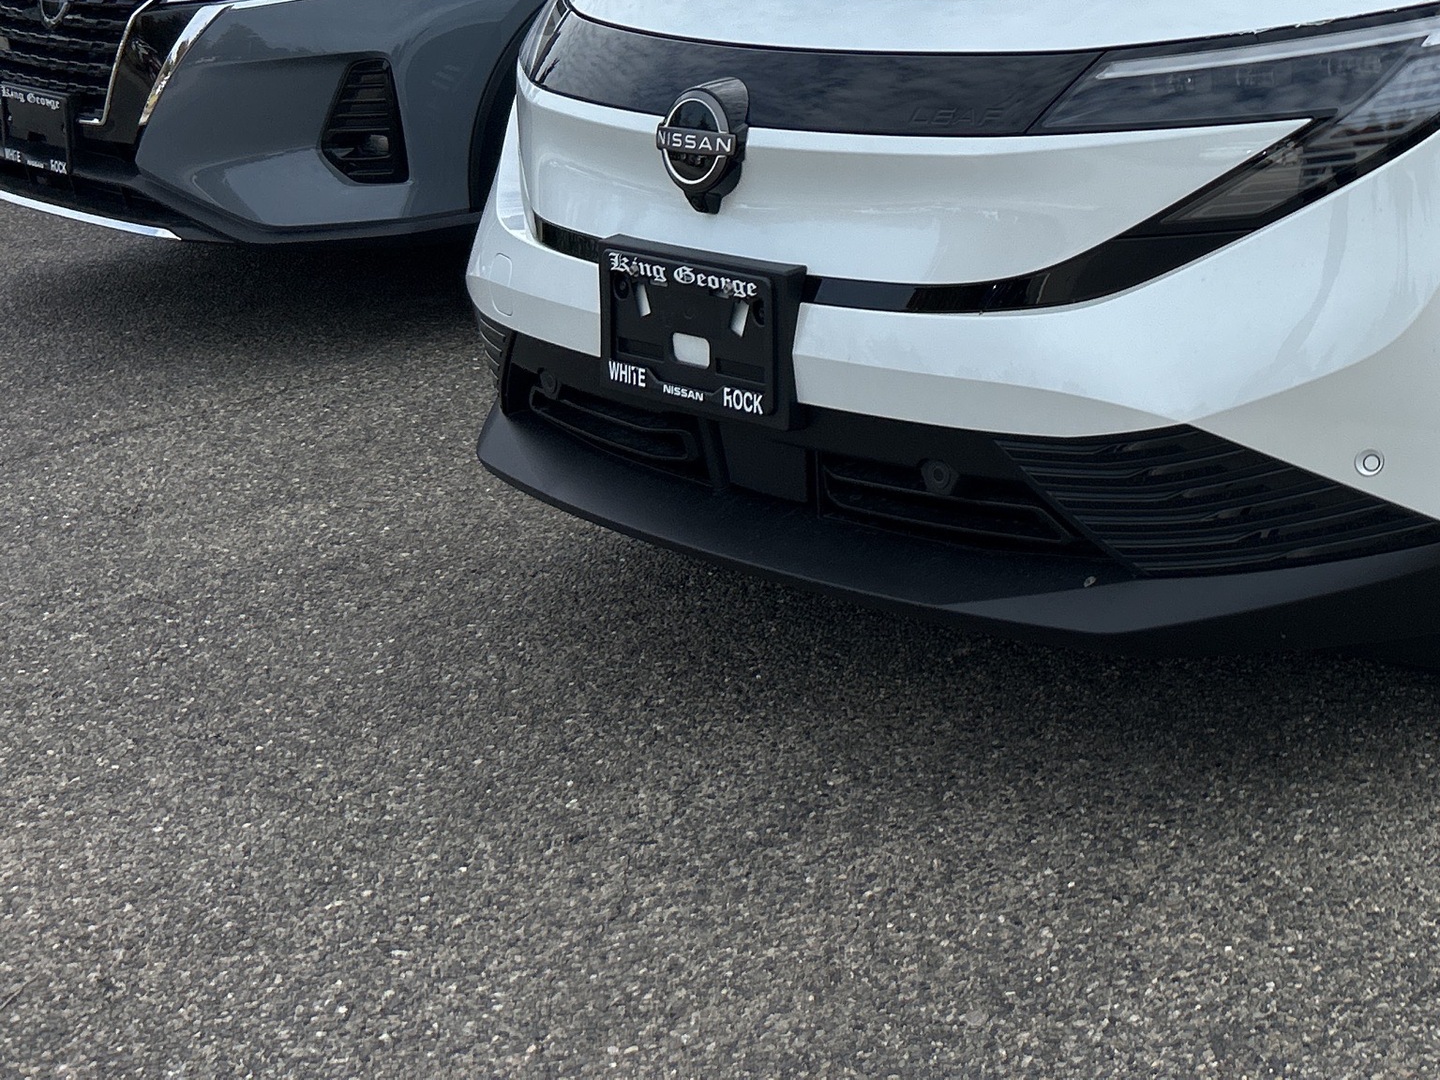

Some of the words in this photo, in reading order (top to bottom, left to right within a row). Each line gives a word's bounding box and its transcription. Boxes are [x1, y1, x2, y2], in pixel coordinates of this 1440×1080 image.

[657, 129, 732, 153] NISSAN
[673, 266, 758, 298] George
[608, 360, 646, 387] WHITE
[662, 384, 704, 402] NISSAN
[723, 387, 764, 415] ROCK
